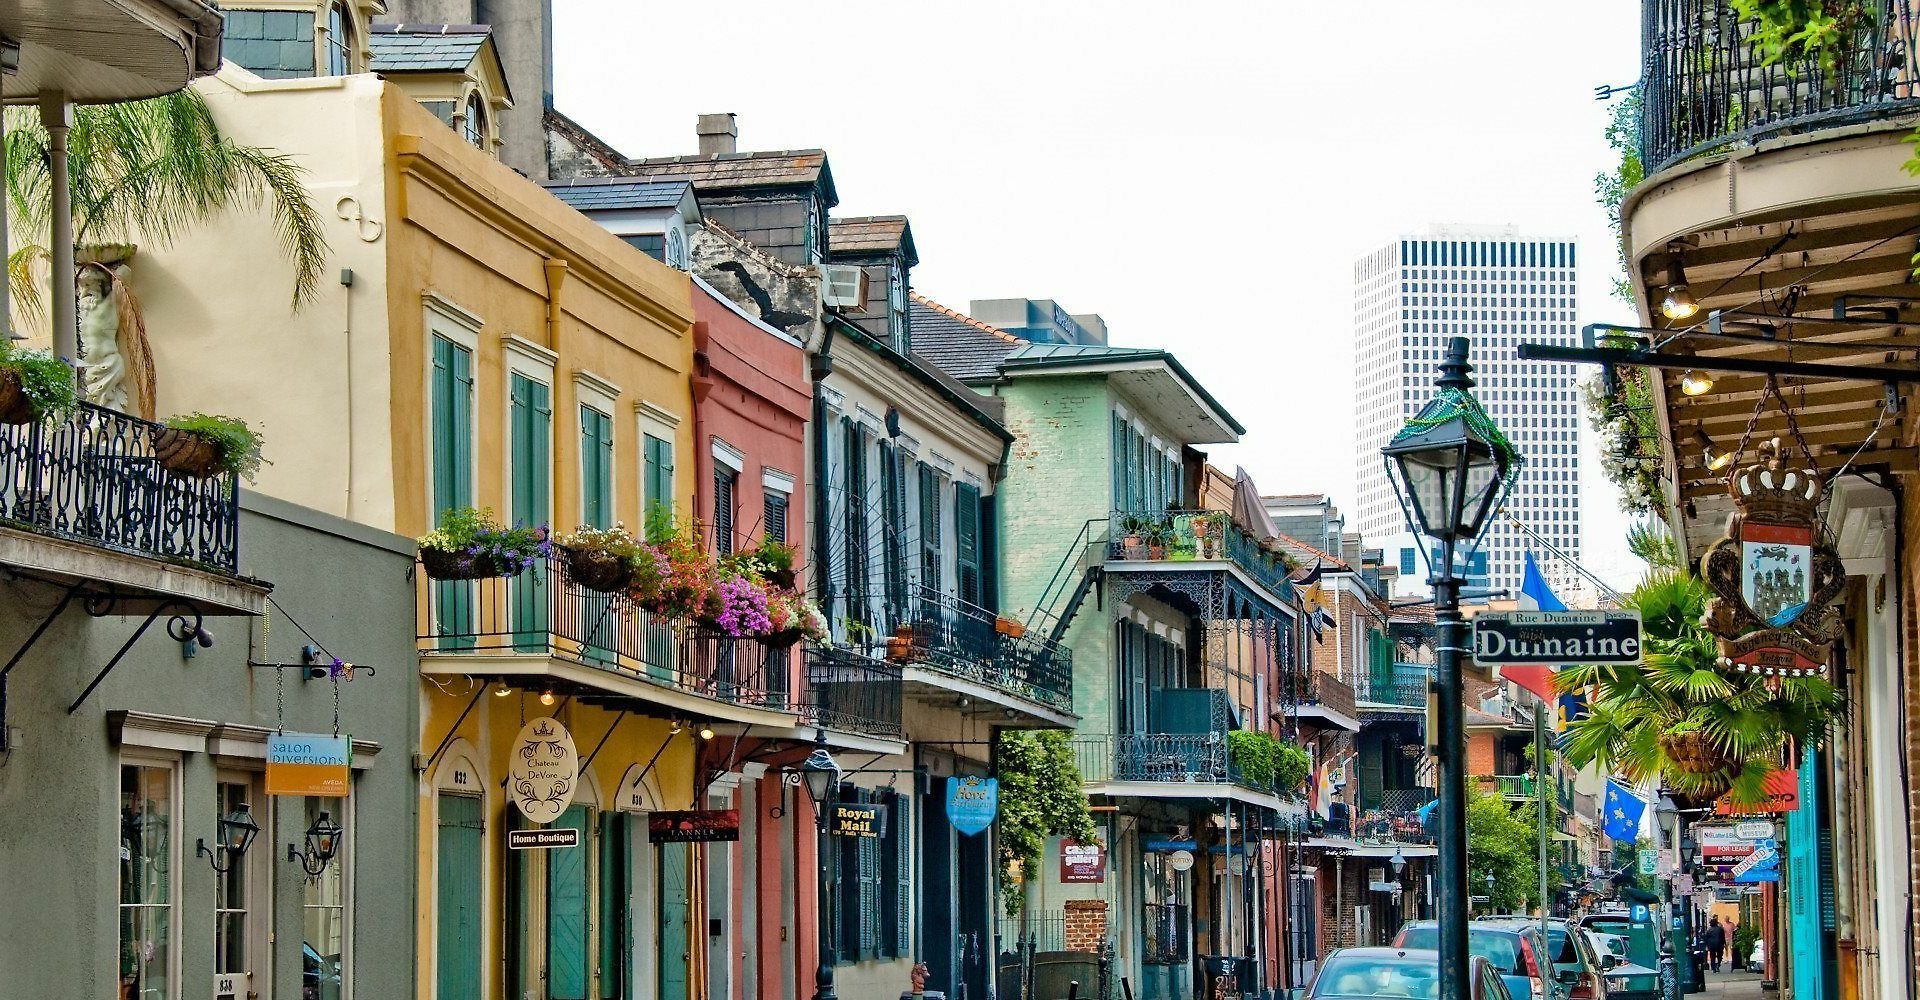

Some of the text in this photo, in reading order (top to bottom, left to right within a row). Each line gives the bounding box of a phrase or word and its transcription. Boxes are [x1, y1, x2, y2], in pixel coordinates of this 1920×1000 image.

[1515, 612, 1598, 623] Rue Dumaine
[1477, 627, 1638, 658] Dumaine
[527, 759, 559, 768] Chateau
[454, 770, 467, 784] 832
[528, 770, 558, 779] DeVore
[632, 794, 643, 806] 830
[837, 807, 876, 820] Royal
[840, 820, 871, 831] Mail
[671, 828, 716, 836] TANNER
[512, 833, 575, 845] Home Boutique
[1065, 855, 1099, 866] gallery
[1636, 904, 1646, 920] P
[1673, 918, 1680, 927] P
